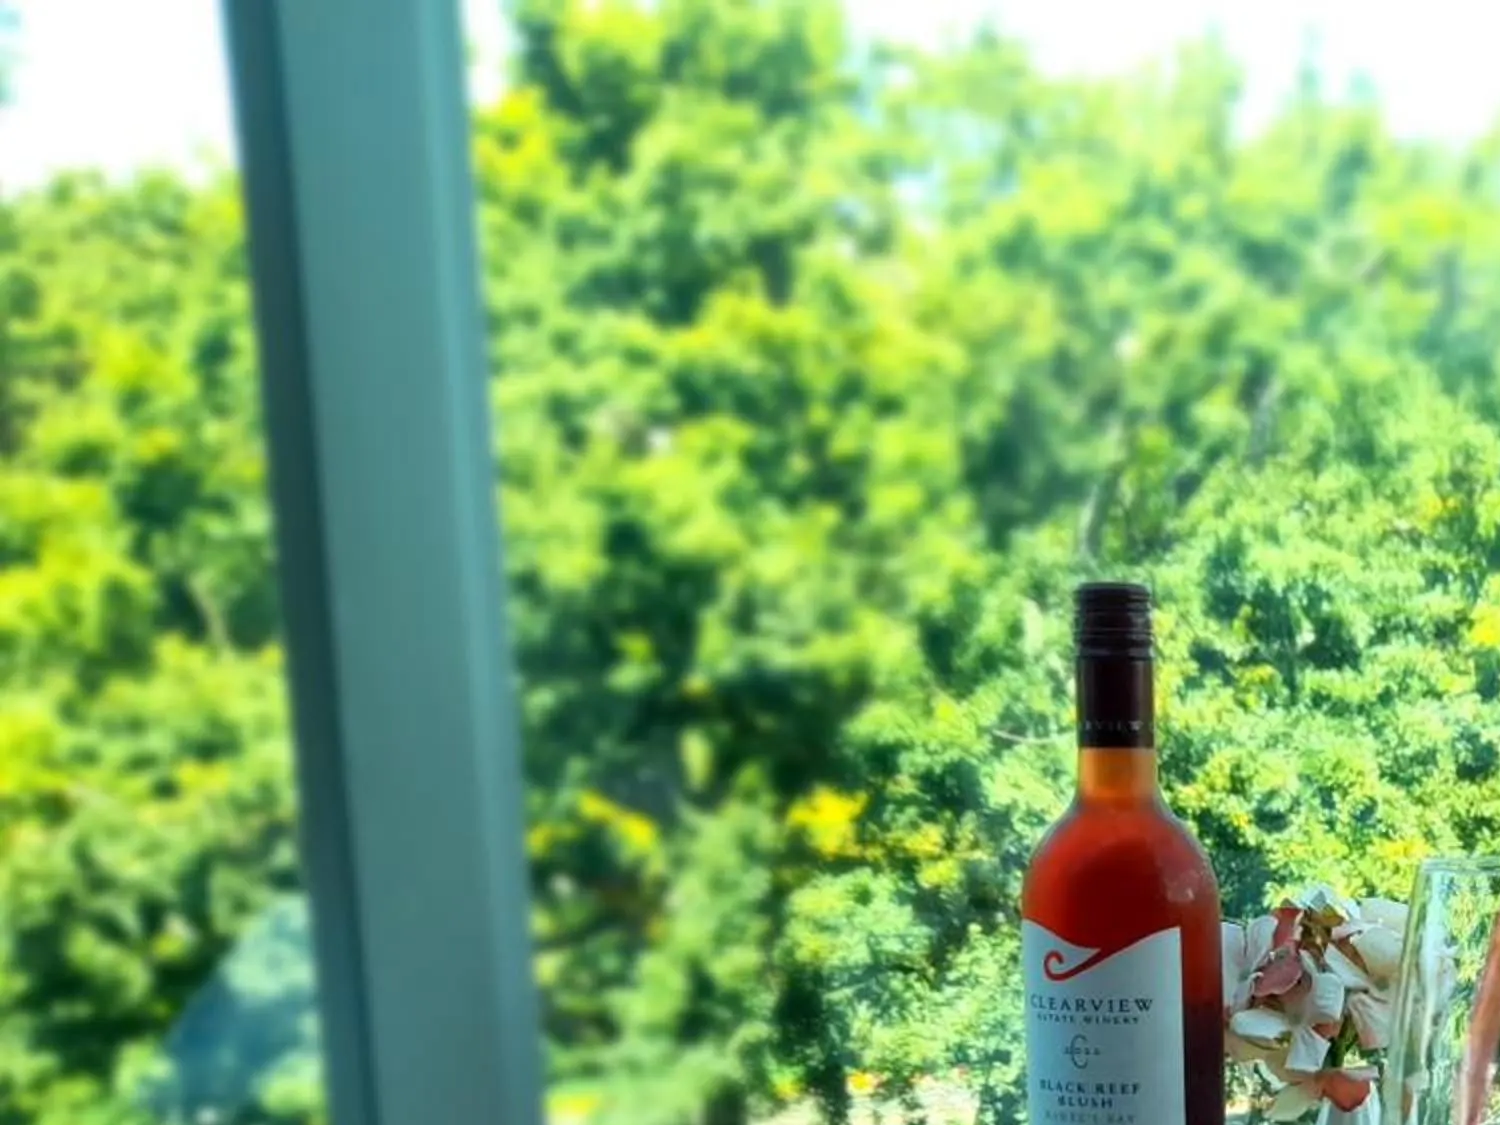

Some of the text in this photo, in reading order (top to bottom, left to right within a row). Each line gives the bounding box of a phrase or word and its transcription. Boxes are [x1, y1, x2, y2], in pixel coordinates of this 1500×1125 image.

[1030, 993, 1154, 1013] CLEARVIEW
[1083, 1015, 1139, 1025] WINERY
[1040, 1079, 1140, 1095] BLACK REEF
[1057, 1095, 1113, 1108] BLUSH
